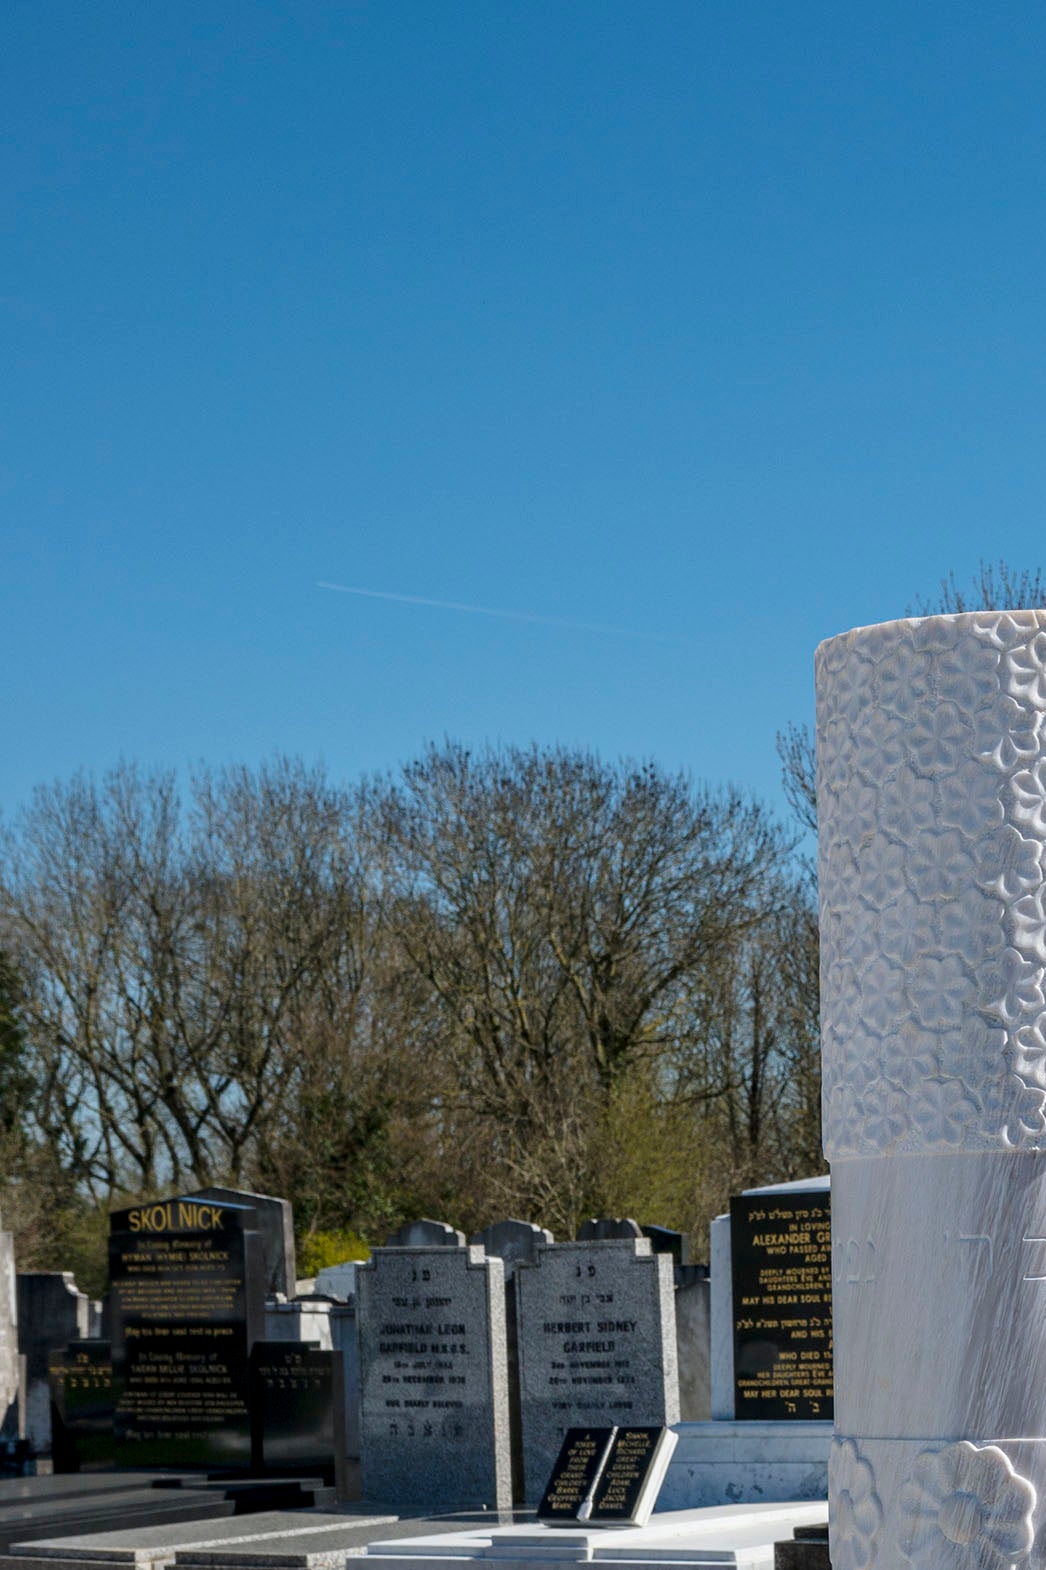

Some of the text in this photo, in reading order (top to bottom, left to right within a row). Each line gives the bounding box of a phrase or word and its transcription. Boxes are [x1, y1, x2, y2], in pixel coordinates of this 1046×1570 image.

[128, 1203, 224, 1232] SKOLNICK
[789, 1222, 831, 1231] IN LOVING
[752, 1233, 811, 1246] ALEXANDER
[766, 1245, 818, 1255] WHO PASSED
[804, 1254, 827, 1262] AGED
[742, 1295, 820, 1305] MAY HIS DEAR SOUL
[438, 1323, 466, 1336] LEON
[543, 1320, 637, 1334] HERBERT SIDNEY
[791, 1331, 808, 1339] AND
[563, 1340, 615, 1353] GARFIELD
[778, 1352, 820, 1360] WHO DIED
[743, 1389, 822, 1398] MAY HER DEAR SOUL
